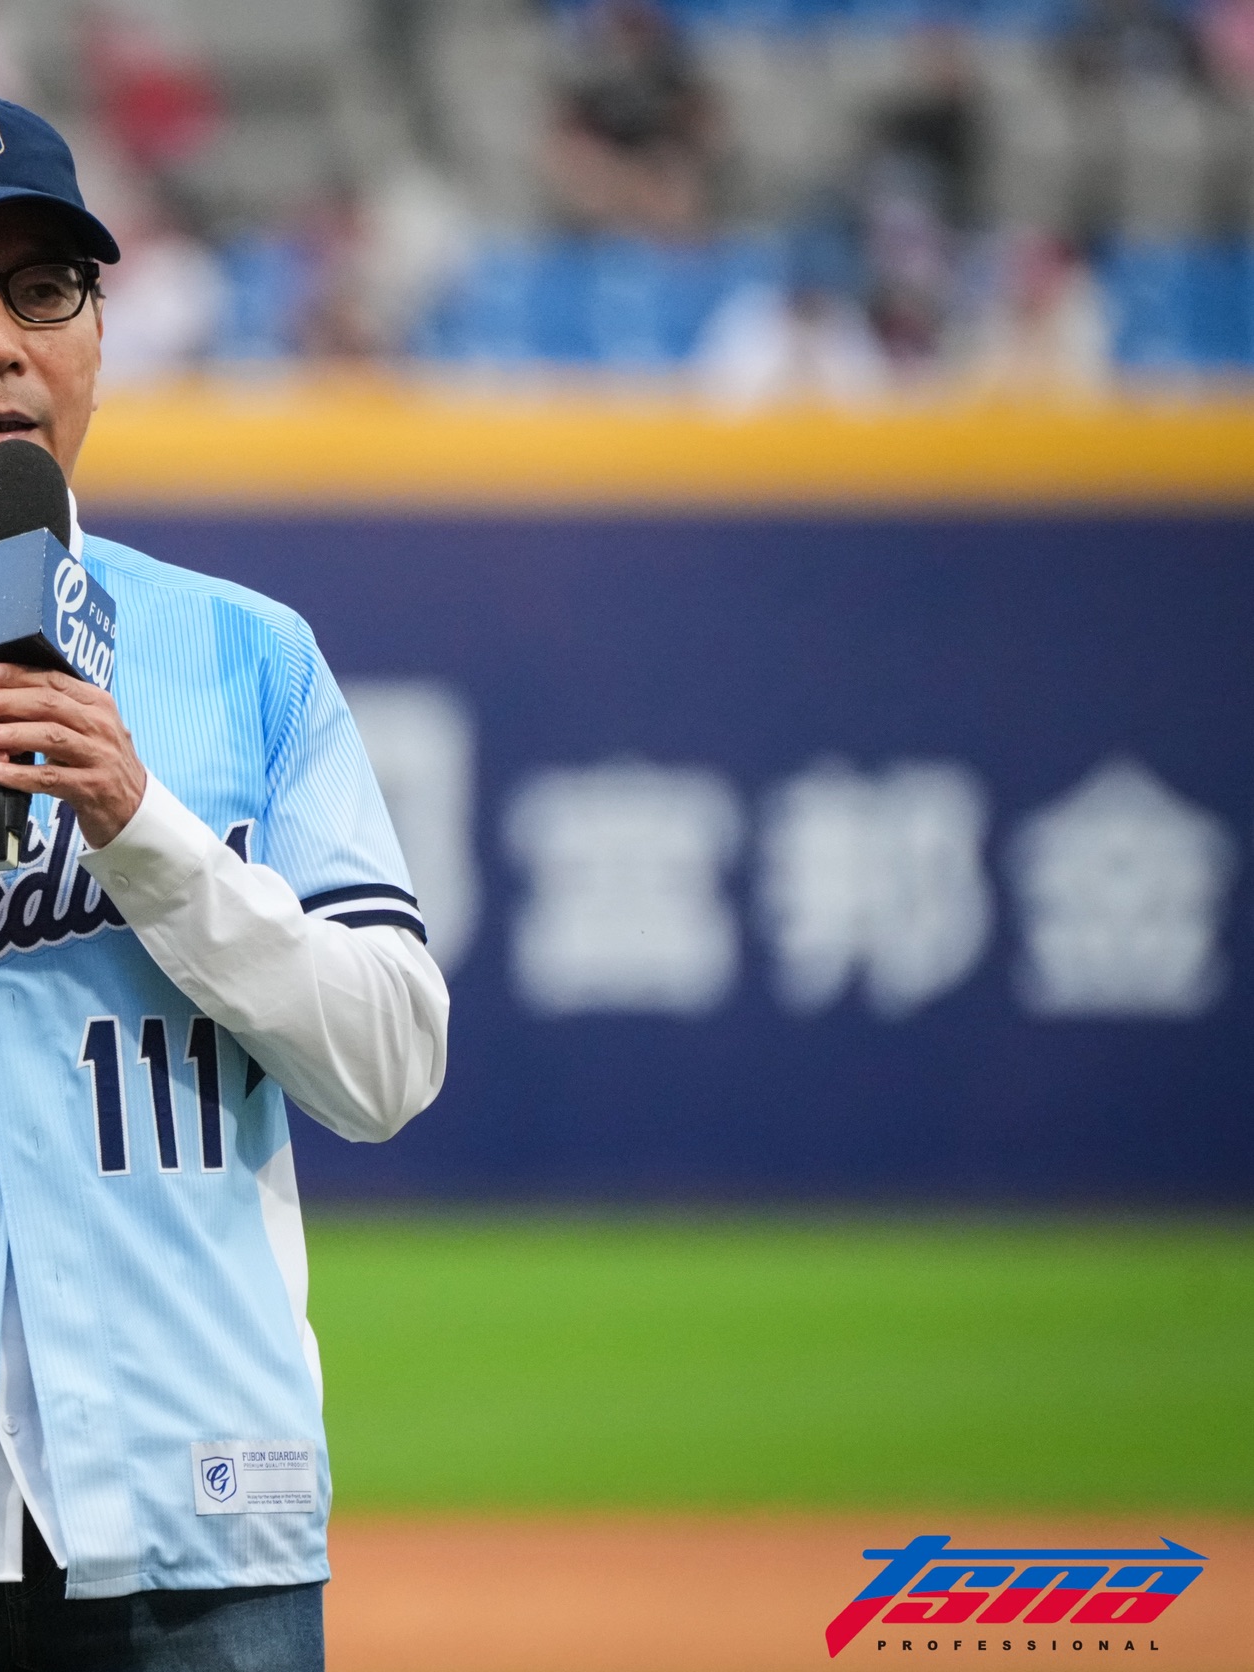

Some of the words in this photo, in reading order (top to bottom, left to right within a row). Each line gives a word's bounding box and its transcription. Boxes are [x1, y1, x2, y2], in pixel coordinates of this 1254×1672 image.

[53, 557, 115, 697] Gua
[77, 1014, 226, 1177] 111
[242, 1451, 266, 1461] FUBON
[268, 1450, 309, 1461] GUARDIANS
